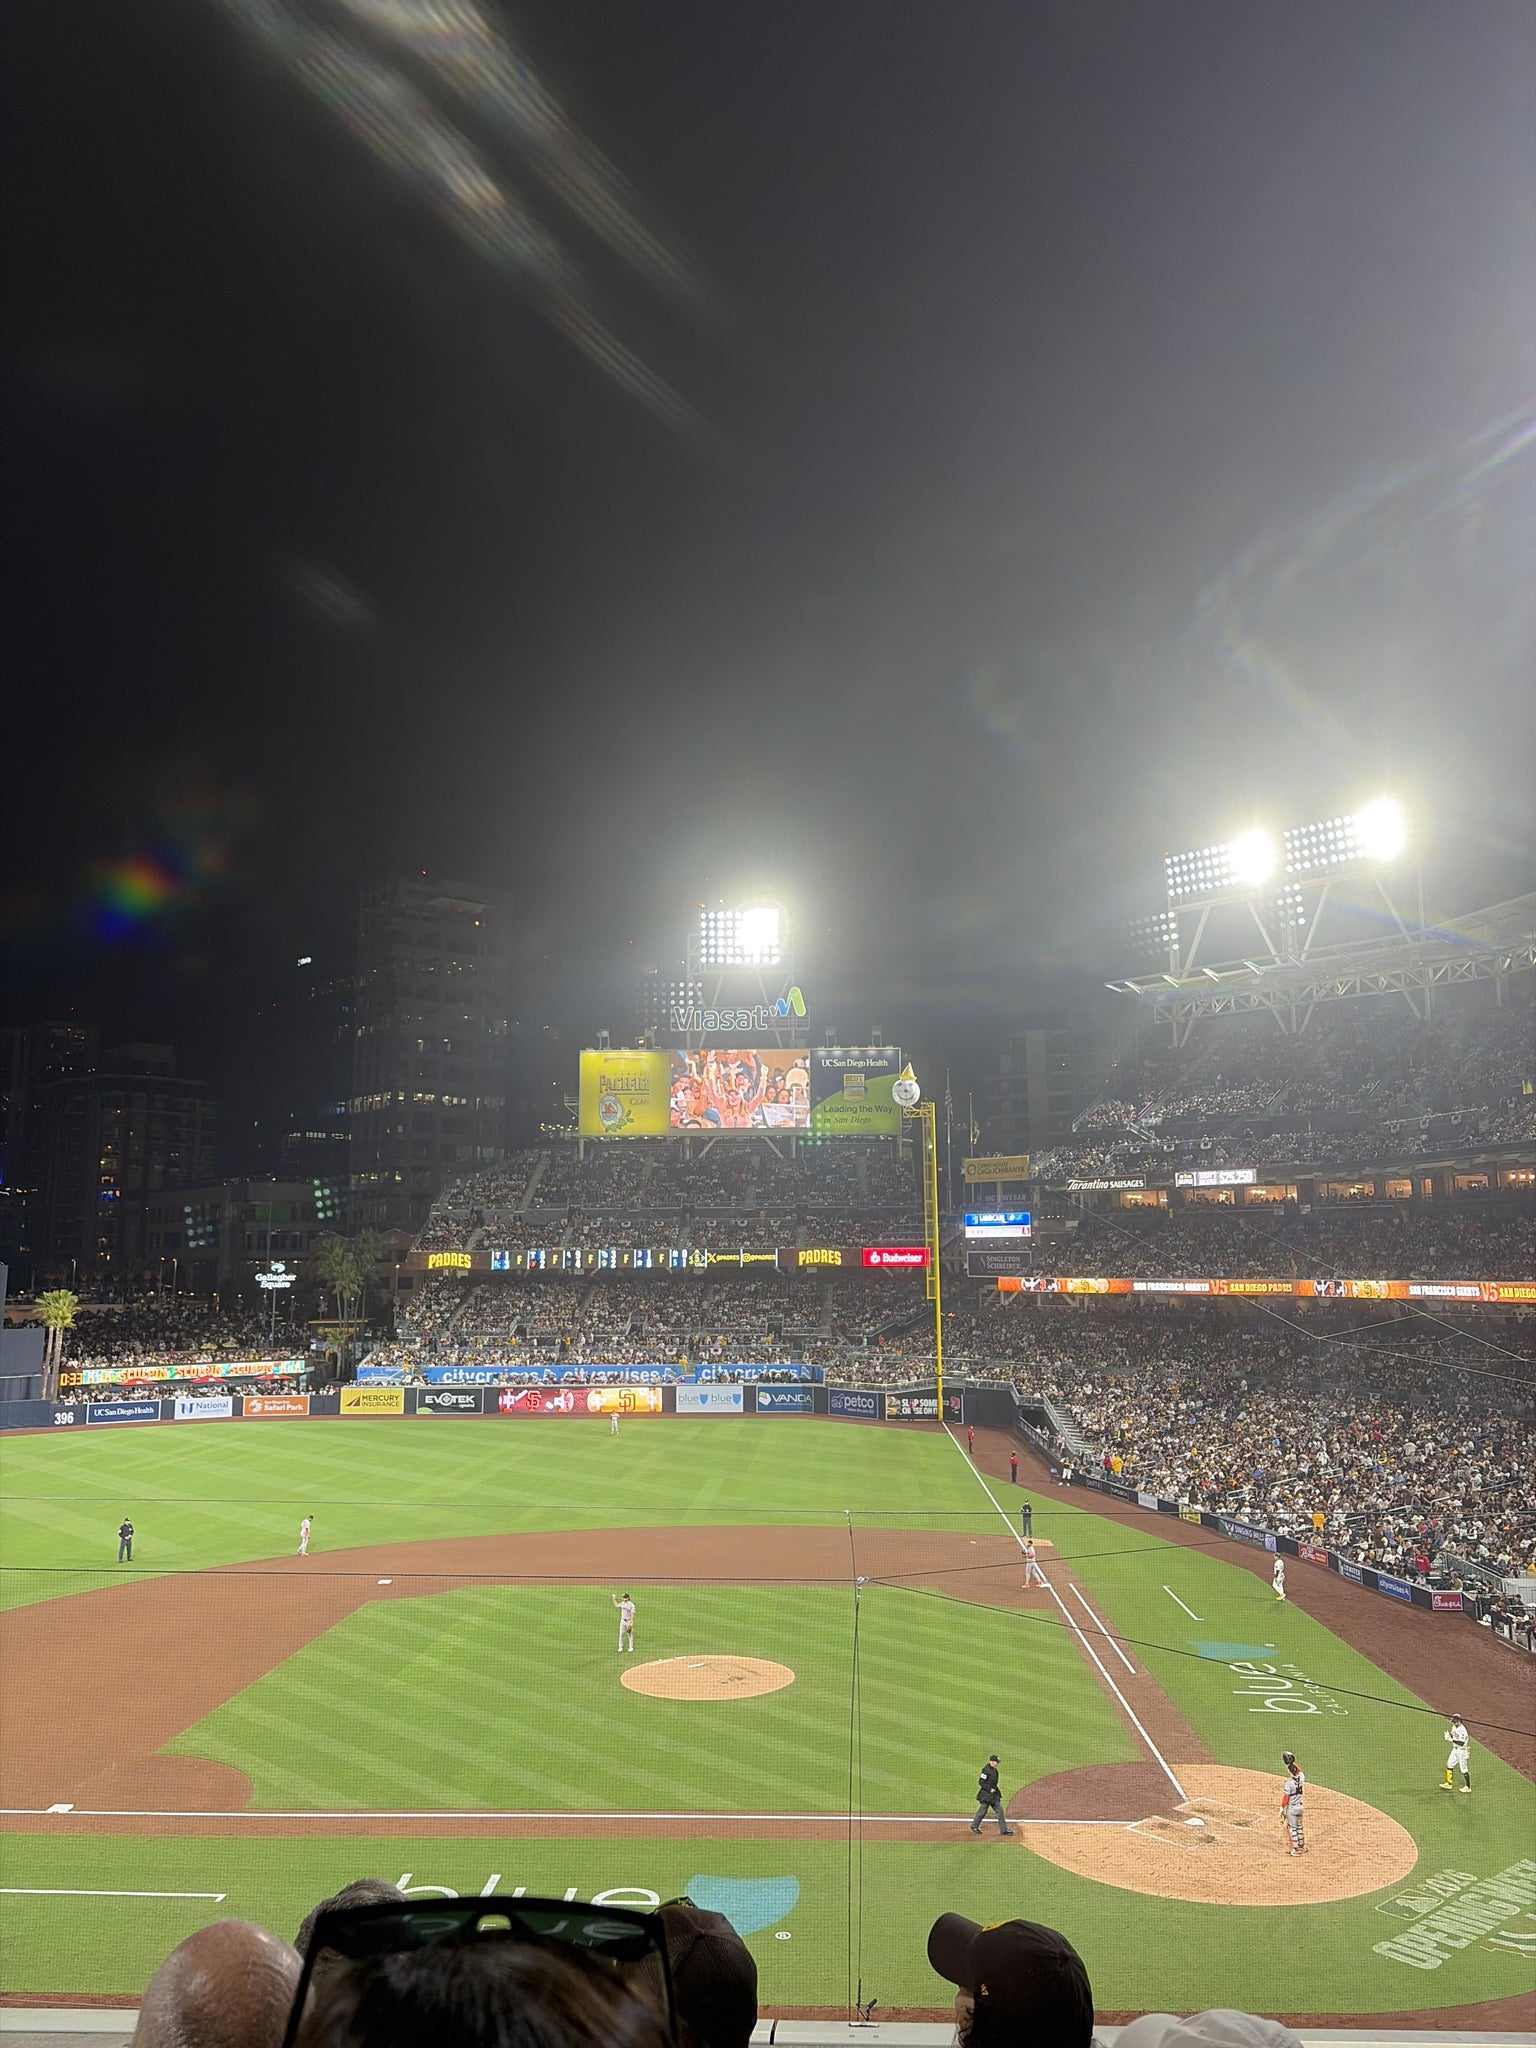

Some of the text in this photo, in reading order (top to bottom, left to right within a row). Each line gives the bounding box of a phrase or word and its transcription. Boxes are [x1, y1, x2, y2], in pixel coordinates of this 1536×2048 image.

[673, 1005, 768, 1031] Viasat
[821, 1058, 889, 1068] UC San Diego Health
[823, 1105, 893, 1114] Leading the Way
[833, 1116, 848, 1124] San
[850, 1115, 872, 1125] Diego
[1067, 1178, 1144, 1191] Tarantino SAUSAGES
[428, 1252, 472, 1269] PADRES
[798, 1249, 842, 1266] PADRES
[882, 1252, 923, 1263] Budweiser
[255, 1273, 297, 1282] Gallagher
[260, 1280, 291, 1289] Square
[1245, 1283, 1267, 1292] DIEGO
[1499, 1287, 1514, 1298] SAN
[120, 1368, 169, 1382] SCULPIN
[176, 1364, 223, 1378] SCULPIN
[229, 1362, 273, 1376] SCULPIN
[361, 1394, 400, 1402] MERCURY
[424, 1392, 476, 1407] EVOTEK
[678, 1392, 700, 1402] blue
[711, 1392, 732, 1402] blue
[771, 1393, 813, 1403] VANDA
[843, 1394, 875, 1409] petco
[196, 1401, 229, 1410] National
[286, 1403, 303, 1411] Park
[919, 1399, 938, 1408] SOME
[94, 1406, 154, 1416] UC San Diego Health
[54, 1412, 74, 1425] 396
[1229, 1662, 1323, 1715] blue
[1372, 1892, 1521, 1970] OPENING
